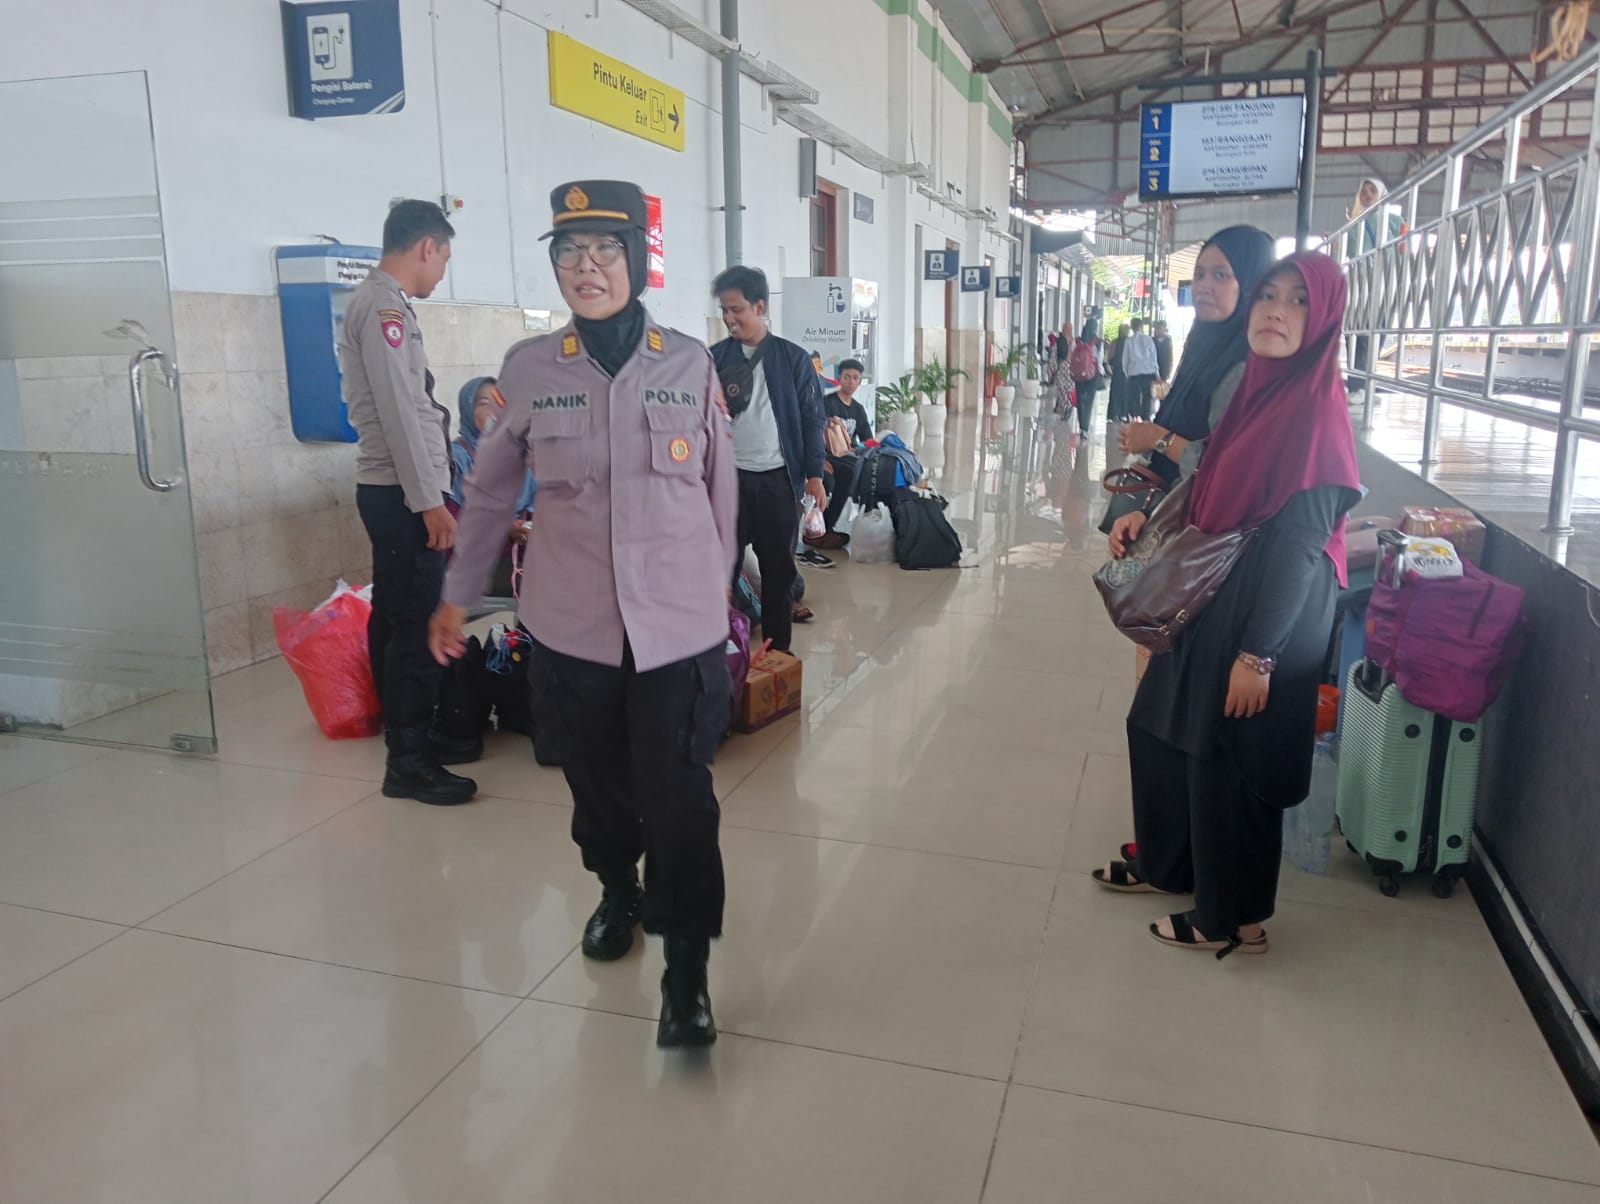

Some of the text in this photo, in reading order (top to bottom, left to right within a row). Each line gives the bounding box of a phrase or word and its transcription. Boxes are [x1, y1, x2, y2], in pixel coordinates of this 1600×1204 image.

[593, 62, 647, 102] Pintu Keluar
[635, 109, 648, 127] Exit
[1152, 115, 1160, 130] 1
[1150, 147, 1160, 161] 2
[1148, 177, 1159, 191] 3
[805, 328, 846, 336] Air Minum
[532, 393, 587, 411] NANIK
[645, 389, 697, 407] POLRI
